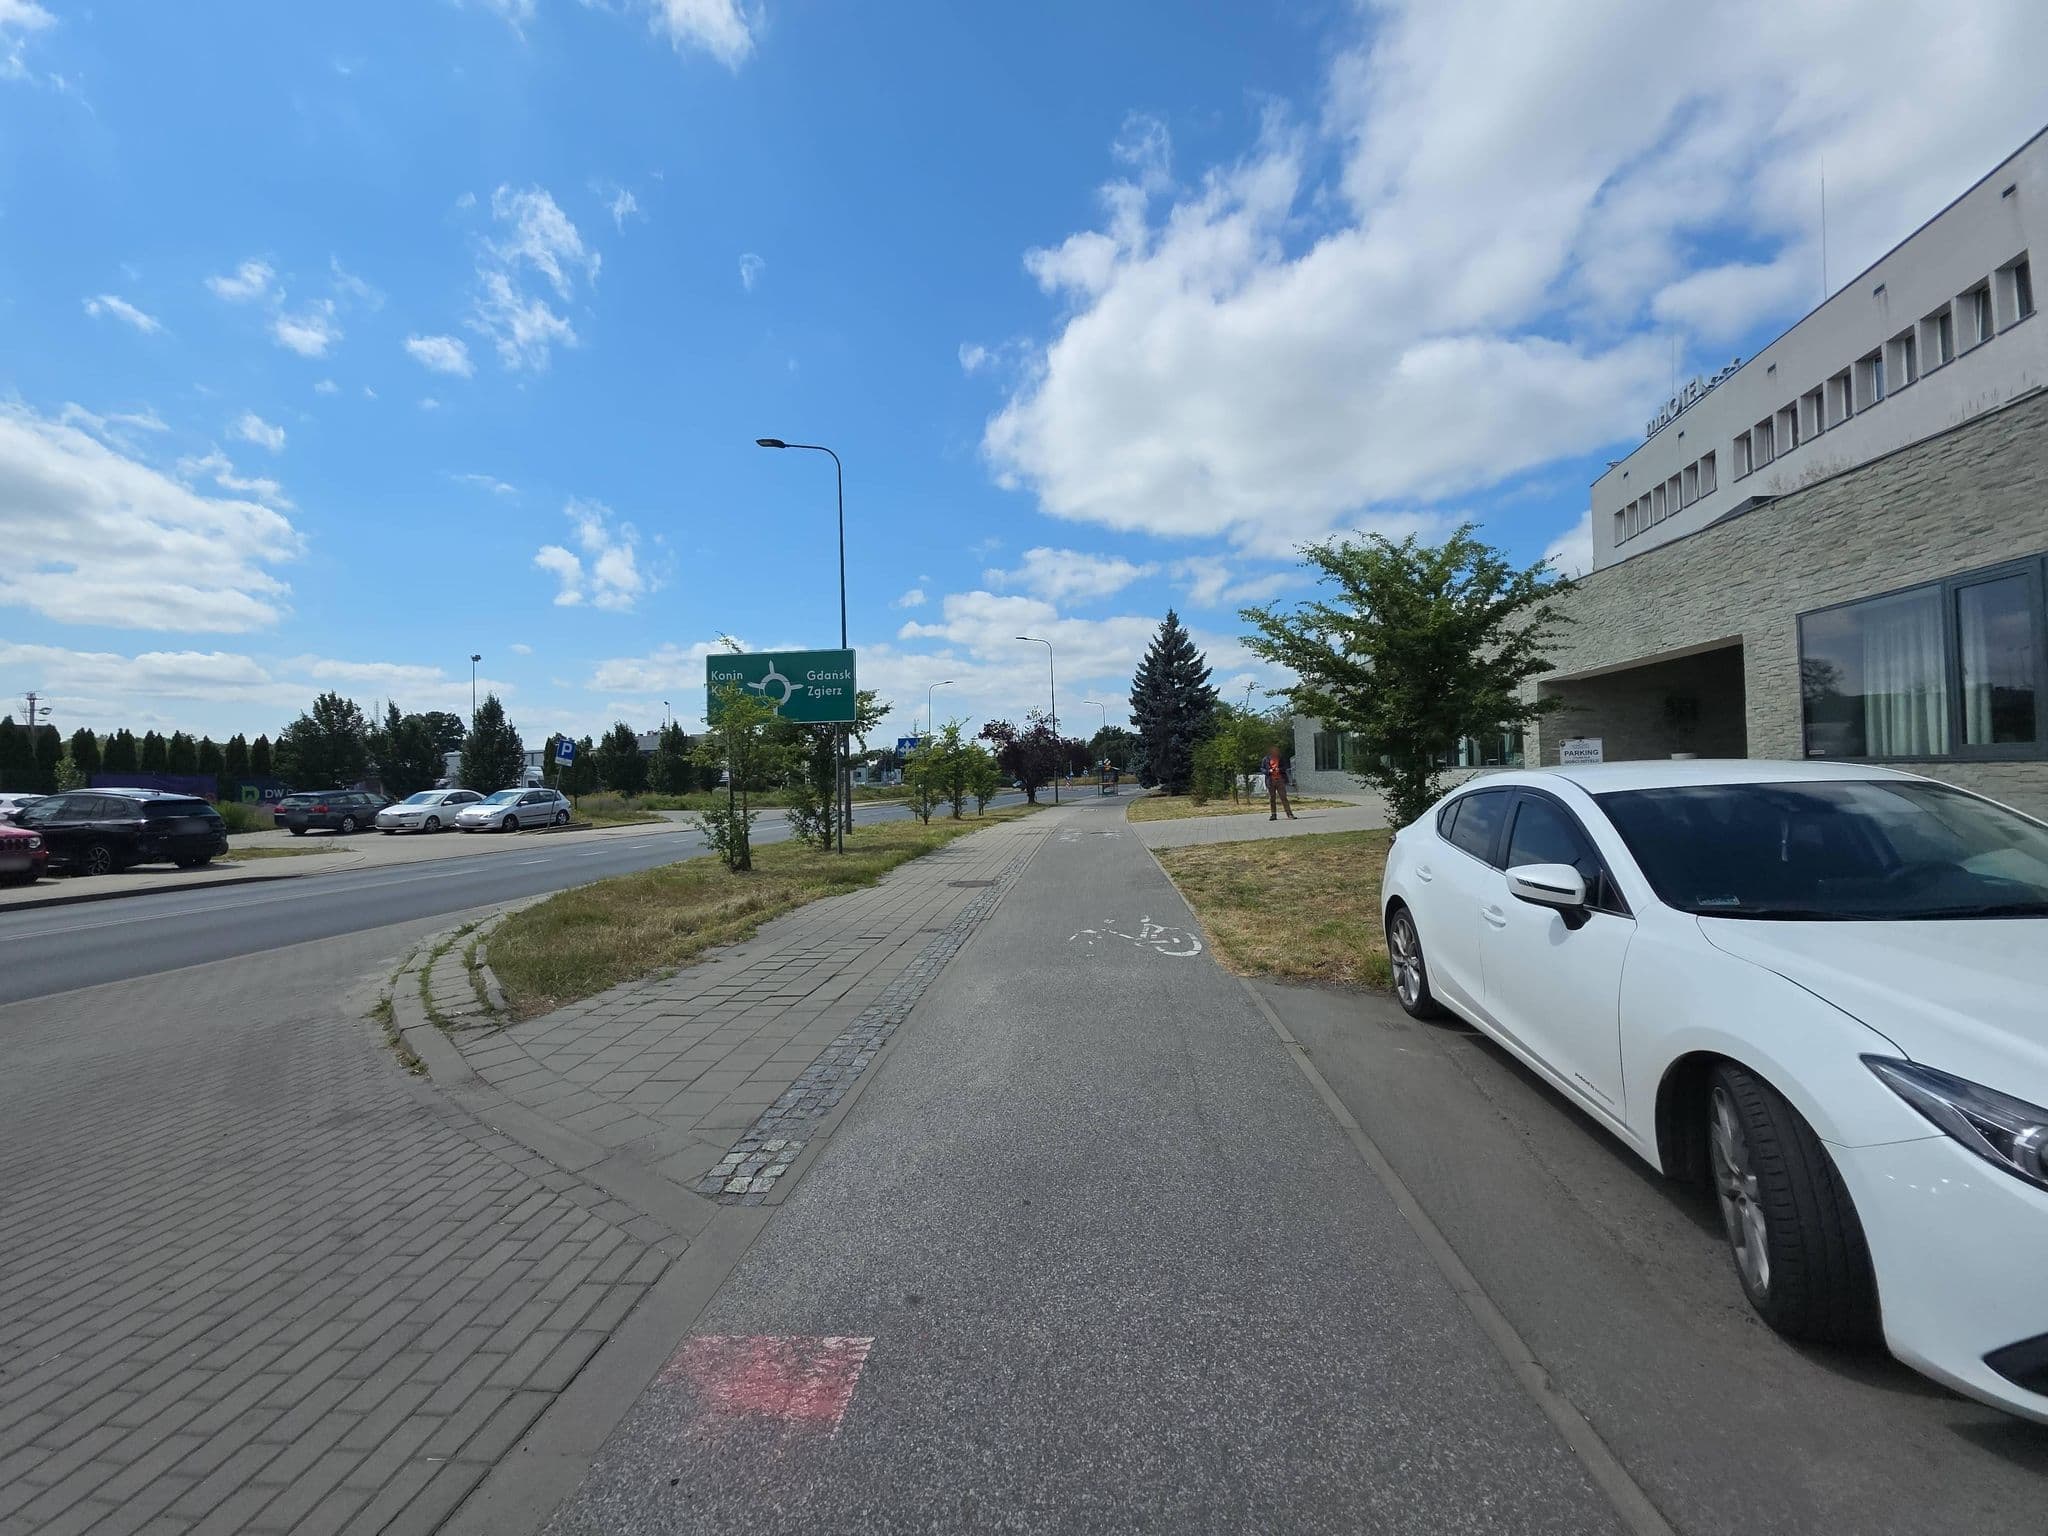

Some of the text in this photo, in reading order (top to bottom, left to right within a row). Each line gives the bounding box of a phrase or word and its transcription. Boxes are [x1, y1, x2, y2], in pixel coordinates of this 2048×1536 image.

[711, 670, 743, 681] Konin
[807, 669, 851, 681] Gdańsk
[807, 685, 843, 699] Zgierz
[561, 742, 573, 756] P
[1564, 749, 1599, 757] PARKING
